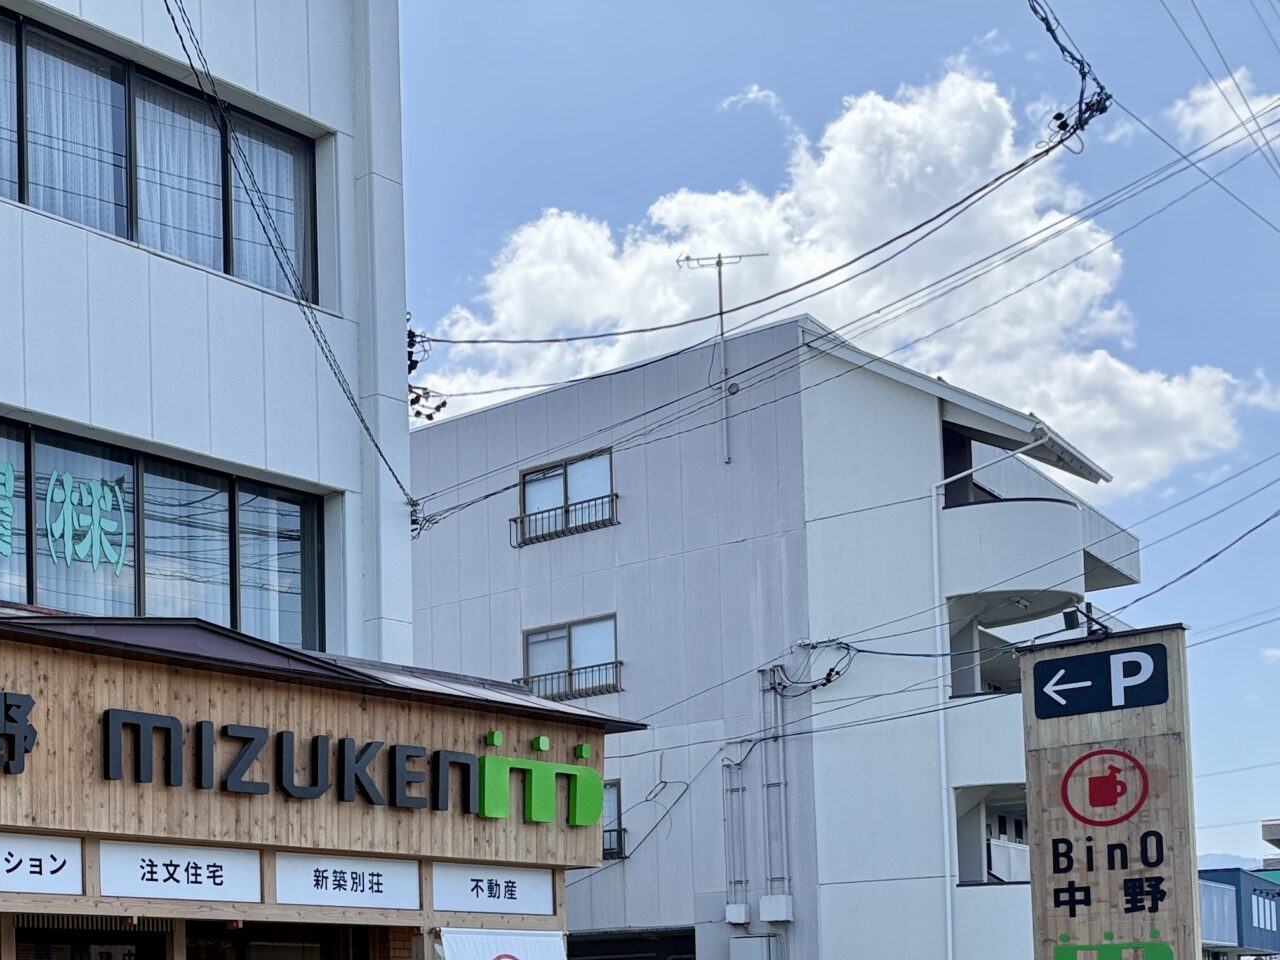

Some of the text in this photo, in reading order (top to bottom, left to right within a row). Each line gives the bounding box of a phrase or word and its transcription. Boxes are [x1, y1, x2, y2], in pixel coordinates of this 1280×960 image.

[1109, 651, 1154, 707] P
[139, 858, 224, 887] 注文住宅
[313, 867, 384, 895] 新築別荘
[470, 878, 518, 901] 不動産
[1052, 875, 1167, 919] 中野
